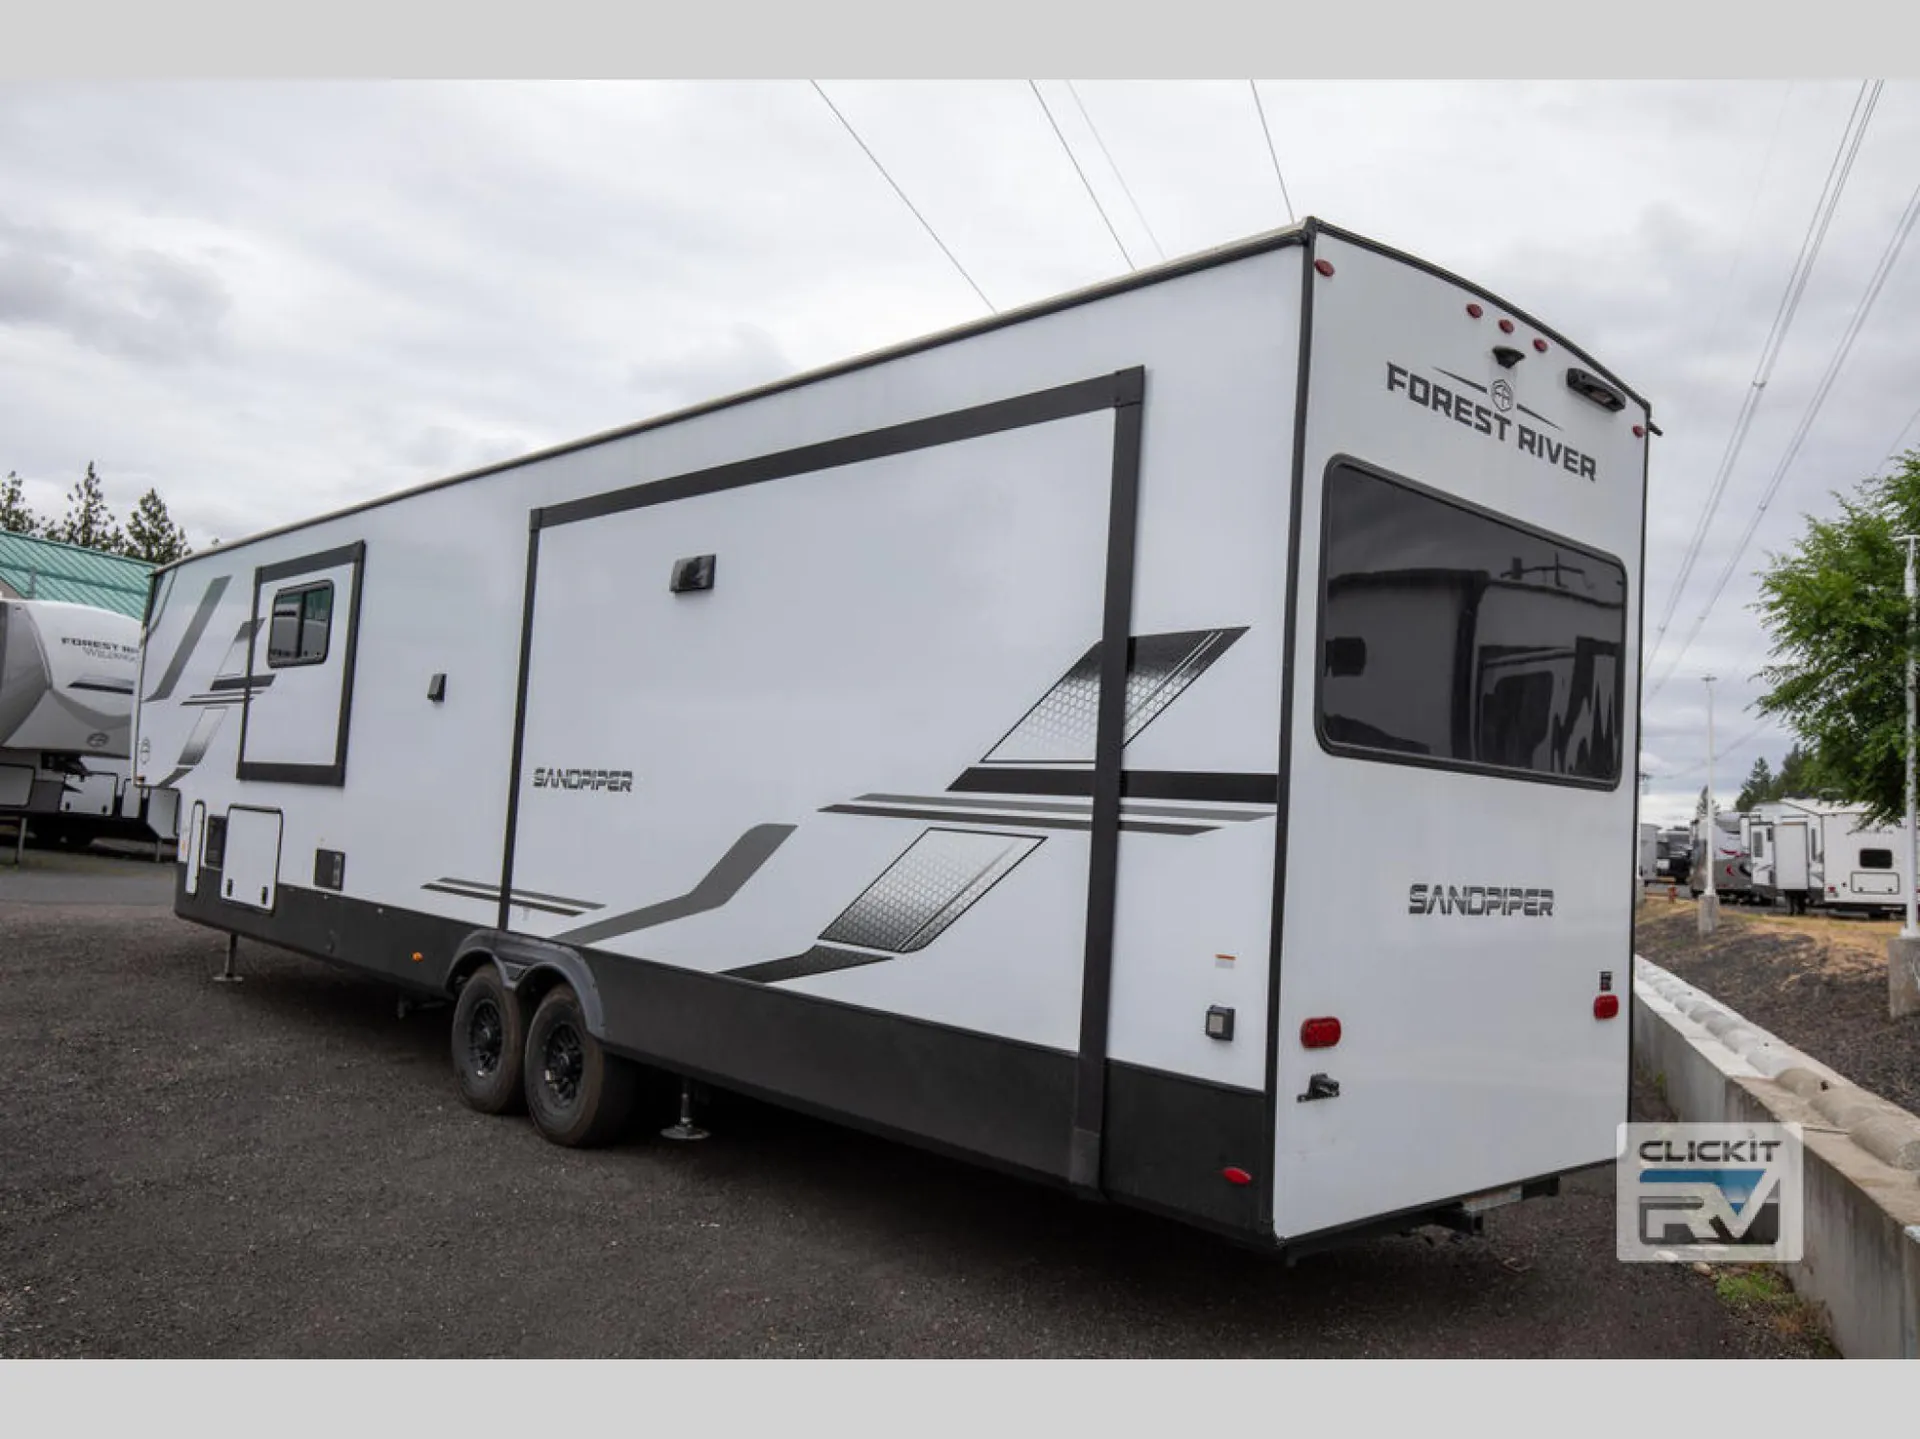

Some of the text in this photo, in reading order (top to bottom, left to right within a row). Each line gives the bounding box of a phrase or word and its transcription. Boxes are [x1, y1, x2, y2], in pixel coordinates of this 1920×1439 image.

[1387, 361, 1597, 481] FOREST RIVER
[61, 637, 118, 652] FOREST
[533, 767, 633, 792] SANDPIPER
[1408, 884, 1554, 916] SANDPIPER
